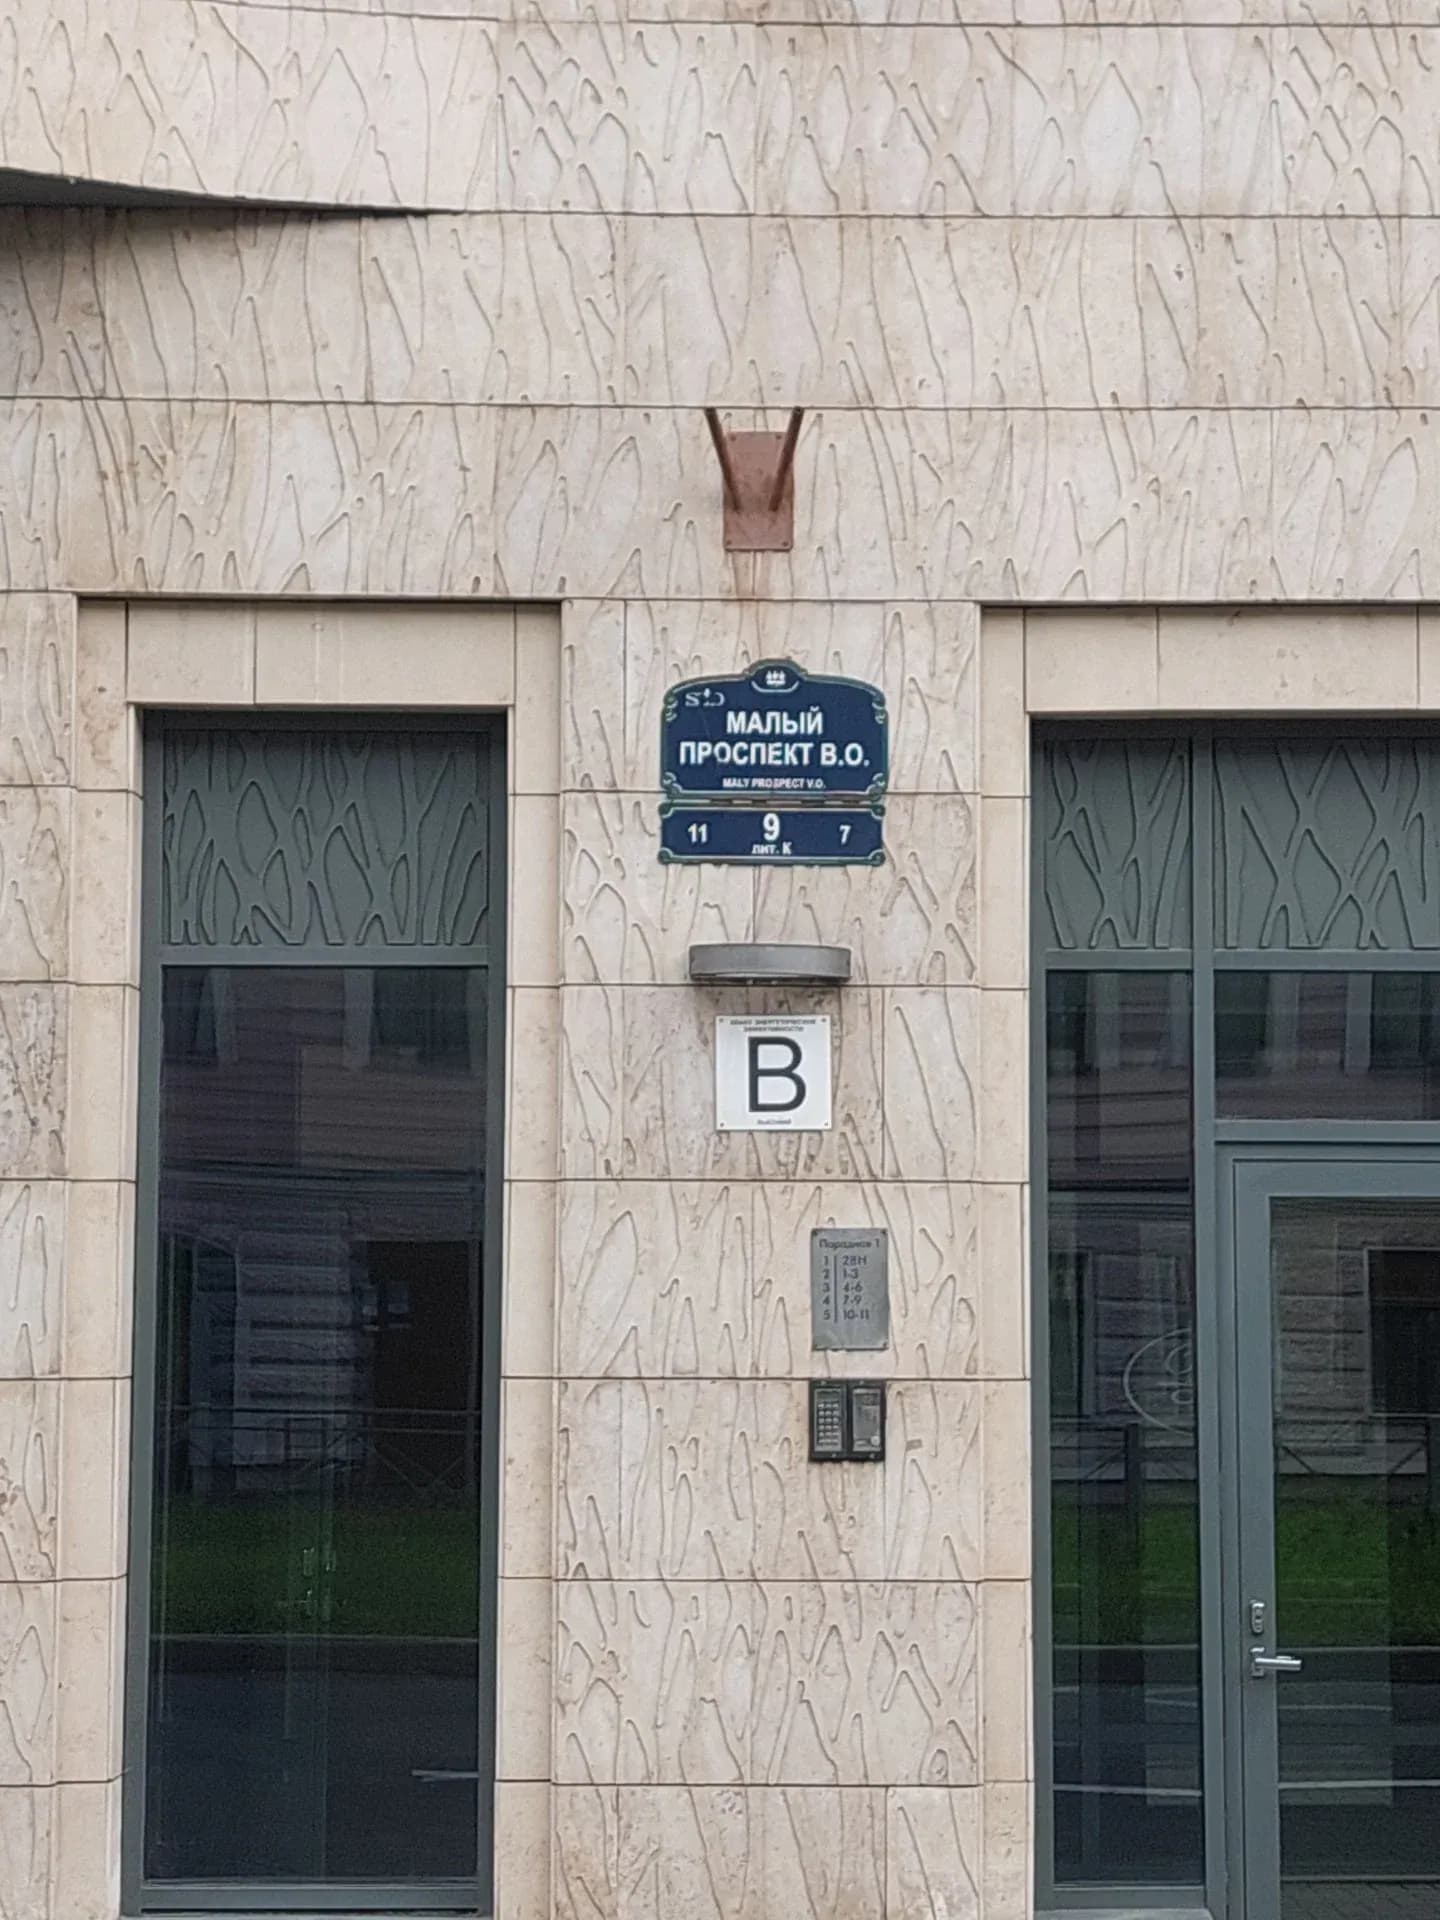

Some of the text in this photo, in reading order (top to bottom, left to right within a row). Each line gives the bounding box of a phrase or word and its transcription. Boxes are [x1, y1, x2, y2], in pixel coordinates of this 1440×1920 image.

[726, 706, 823, 734] МАЛЫЙ
[679, 741, 870, 766] ПРОСПЕКТ В.О.
[722, 777, 749, 788] MALY
[751, 777, 804, 789] PROSPECT
[762, 812, 780, 841] 9
[687, 823, 708, 843] 11
[839, 825, 851, 844] 7
[823, 1255, 829, 1266] 1
[822, 1269, 830, 1279] 2
[822, 1282, 830, 1292] 3
[822, 1295, 830, 1305] 4
[823, 1309, 831, 1320] 5
